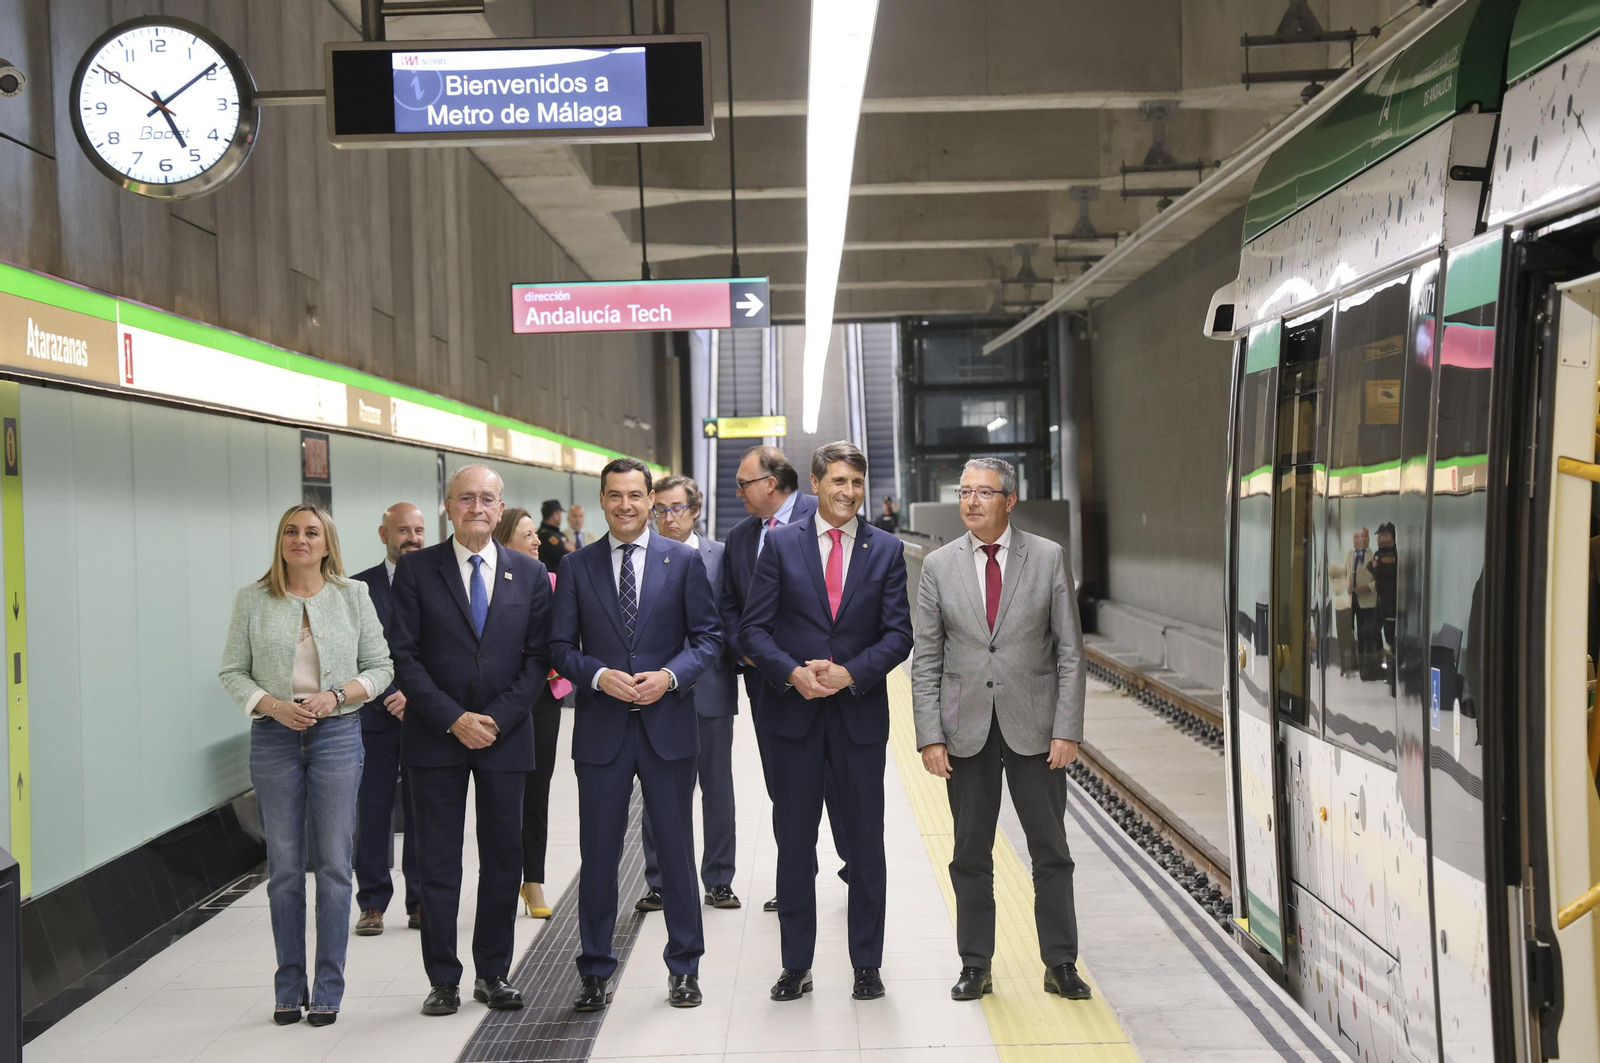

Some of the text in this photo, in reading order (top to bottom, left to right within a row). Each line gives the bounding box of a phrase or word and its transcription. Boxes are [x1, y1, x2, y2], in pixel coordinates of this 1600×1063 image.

[149, 39, 167, 53] 12
[125, 49, 135, 62] 11
[187, 47, 192, 60] 1
[103, 71, 121, 84] 10
[205, 67, 217, 81] 2
[445, 74, 609, 96] Bienvenidos a
[95, 102, 108, 115] 9
[216, 98, 228, 111] 3
[427, 101, 622, 127] Metro de Málaga
[107, 131, 120, 145] 8
[207, 128, 219, 141] 4
[132, 151, 144, 165] 7
[189, 149, 201, 162] 5
[159, 158, 173, 171] 6
[524, 290, 571, 302] dirección
[525, 303, 672, 326] Andalucía Tech
[26, 316, 89, 368] Atarazanas
[124, 338, 133, 379] 1
